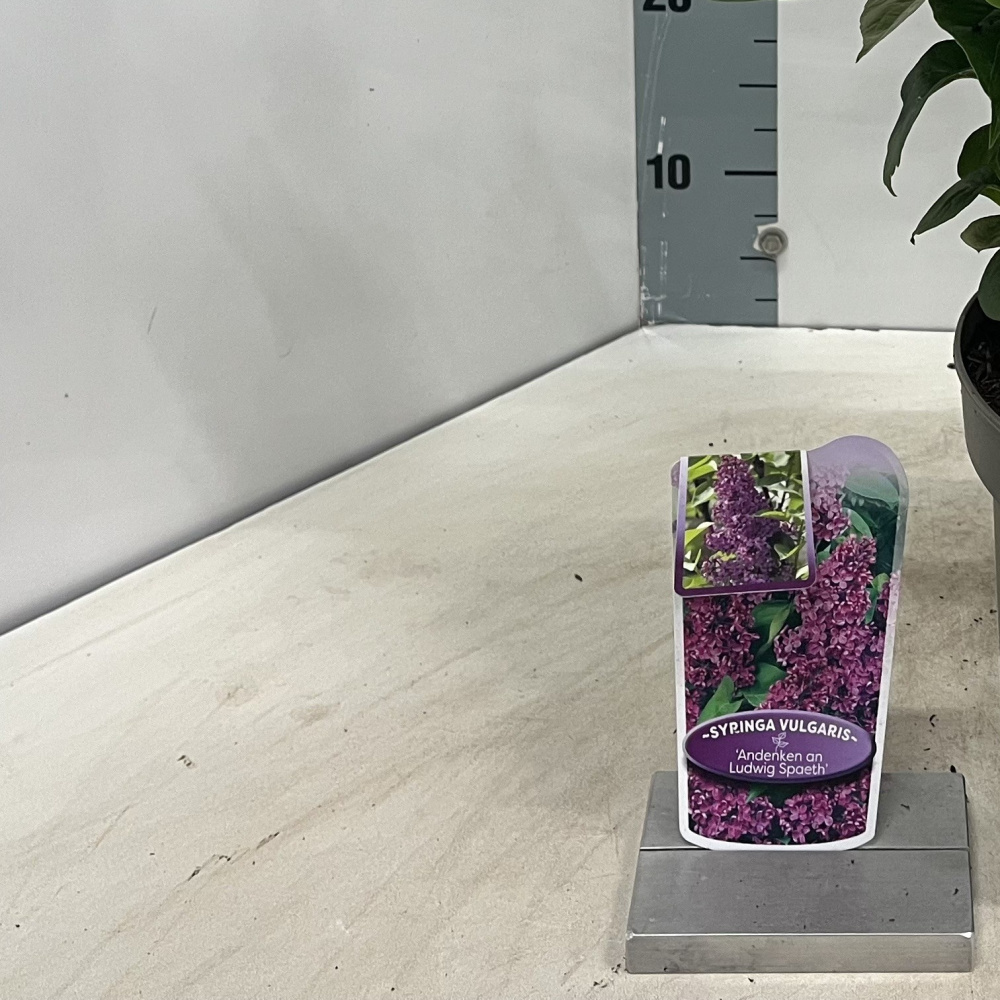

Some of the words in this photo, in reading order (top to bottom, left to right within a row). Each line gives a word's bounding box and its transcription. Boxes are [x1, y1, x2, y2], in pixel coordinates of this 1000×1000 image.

[647, 154, 691, 190] 10
[805, 752, 823, 762] an
[729, 762, 775, 776] Ludwig
